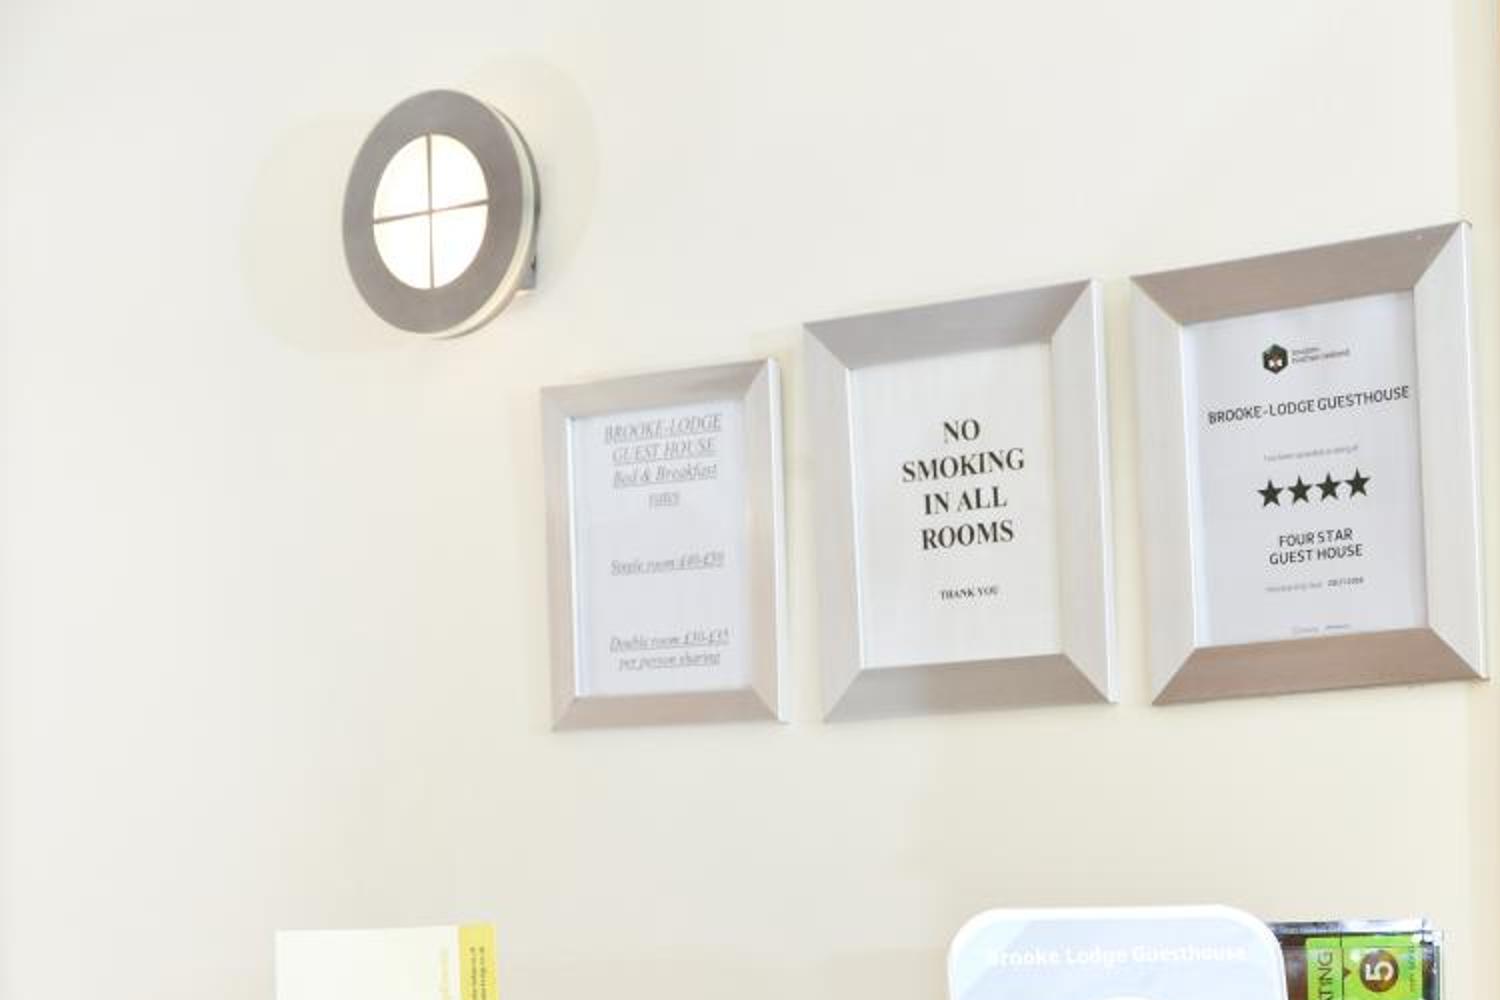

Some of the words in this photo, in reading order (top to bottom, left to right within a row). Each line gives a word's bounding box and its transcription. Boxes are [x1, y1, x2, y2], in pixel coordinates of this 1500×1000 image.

[1208, 397, 1315, 424] BROOKE-LODGE
[1317, 386, 1410, 411] GUESTHOUSE
[943, 419, 980, 443] NO
[902, 448, 1025, 482] SMOKING
[924, 492, 950, 515] IN
[957, 485, 1008, 510] ALL
[922, 520, 1014, 551] ROOMS
[1279, 532, 1315, 548] FOUR
[1317, 528, 1353, 544] STAR
[1269, 548, 1314, 566] GUEST
[1317, 543, 1363, 560] HOUSE
[941, 587, 975, 600] THANK
[977, 585, 999, 597] YOU
[1365, 960, 1394, 981] 5
